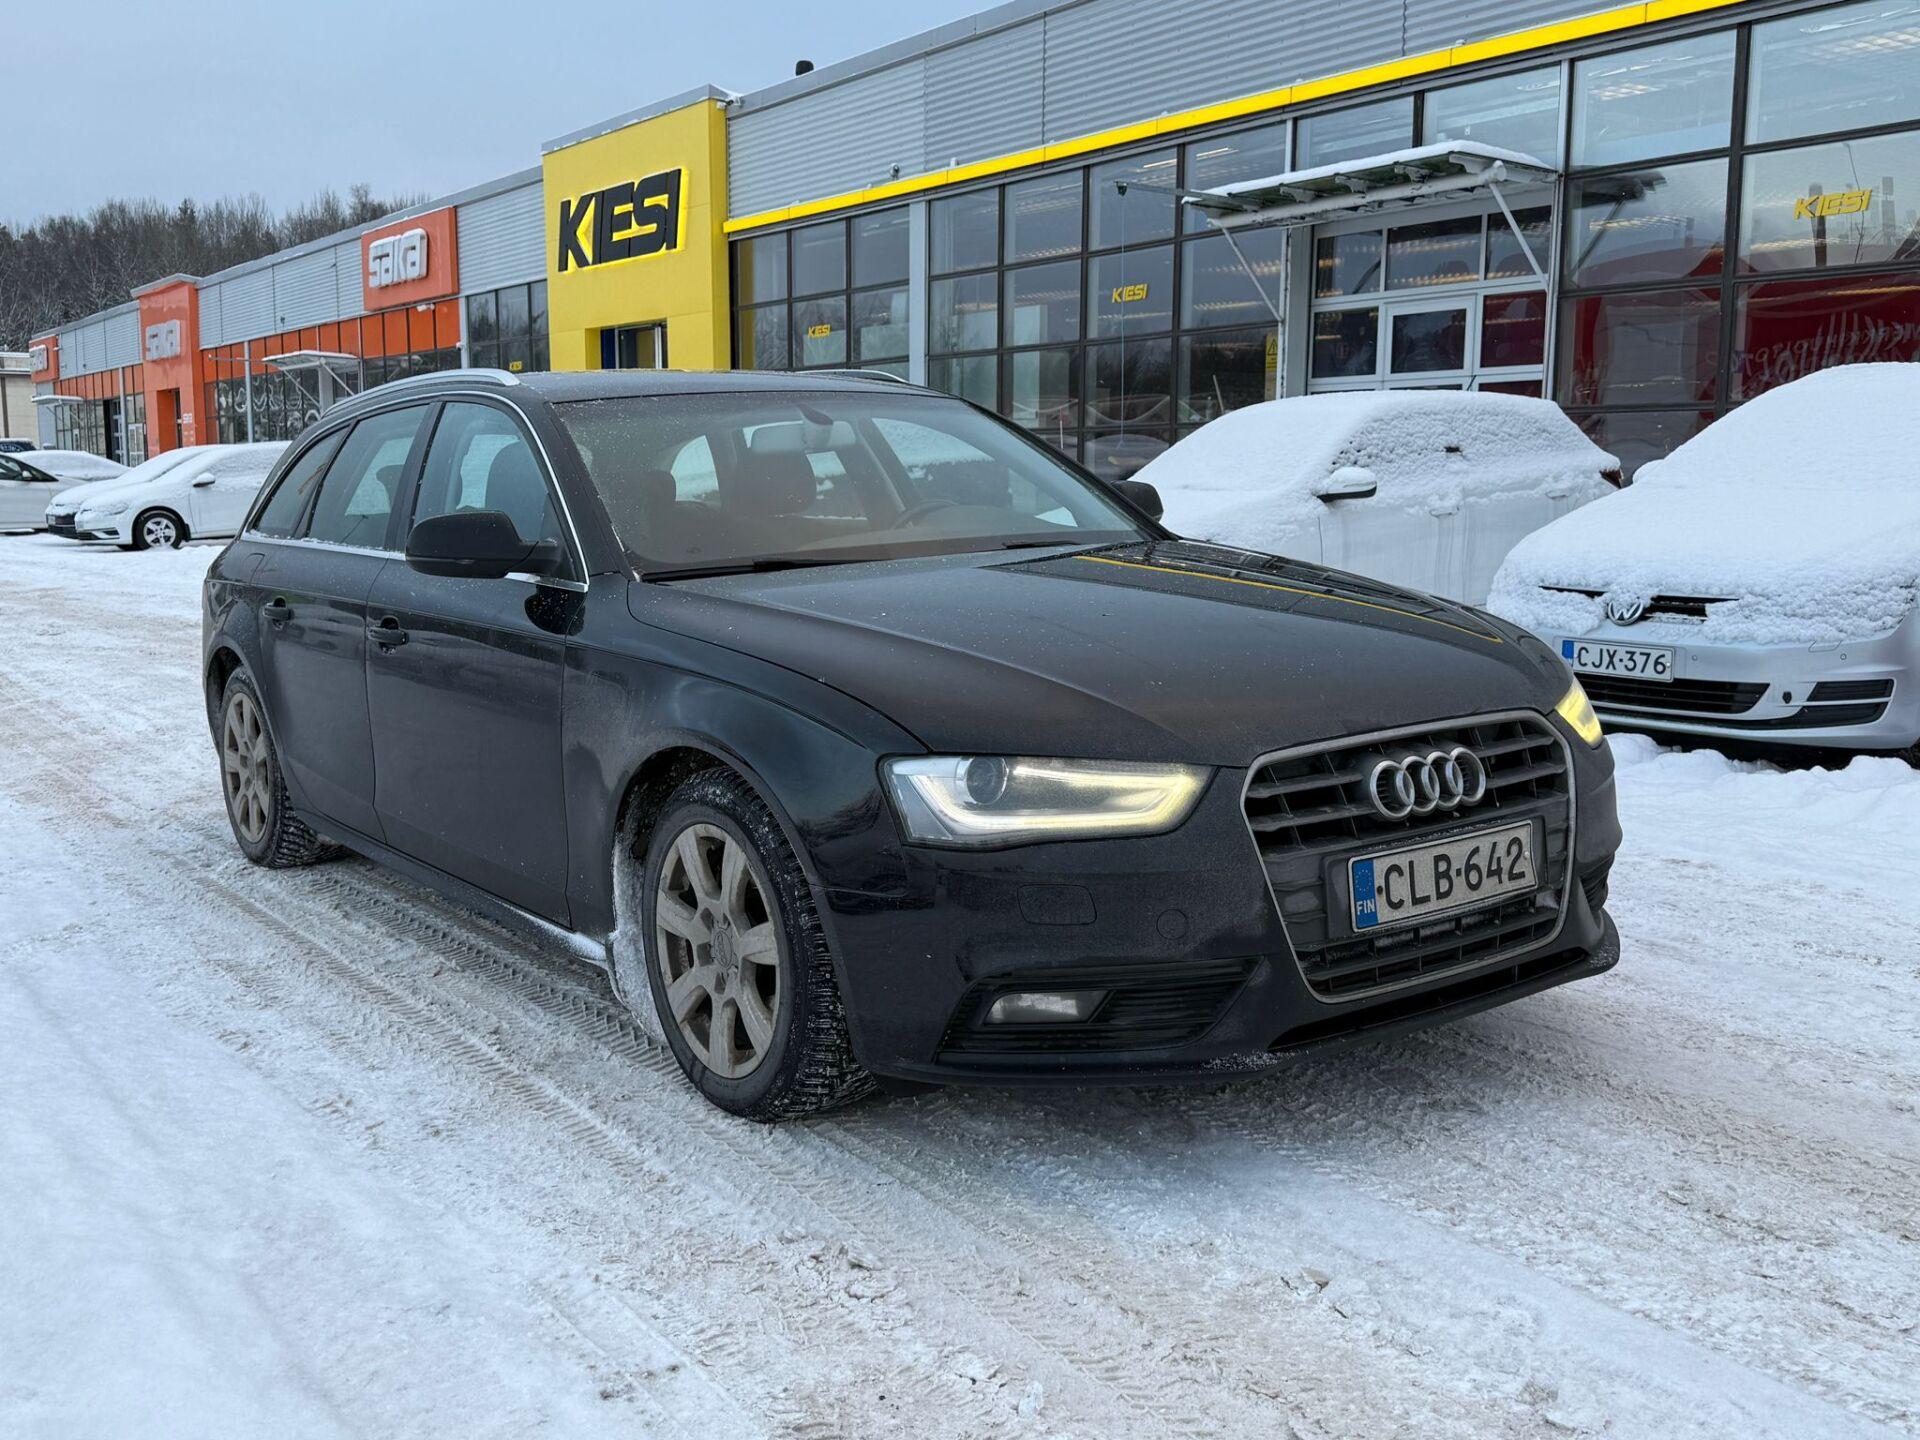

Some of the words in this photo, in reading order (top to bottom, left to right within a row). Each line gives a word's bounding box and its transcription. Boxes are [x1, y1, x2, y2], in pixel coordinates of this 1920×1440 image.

[558, 168, 681, 272] KIESI
[1794, 189, 1872, 222] KIESI
[1111, 283, 1149, 304] KIESI
[807, 324, 831, 338] KIESI
[1577, 646, 1667, 675] CJX-376
[1384, 836, 1526, 910] CLB-642
[1356, 899, 1376, 915] FIN
